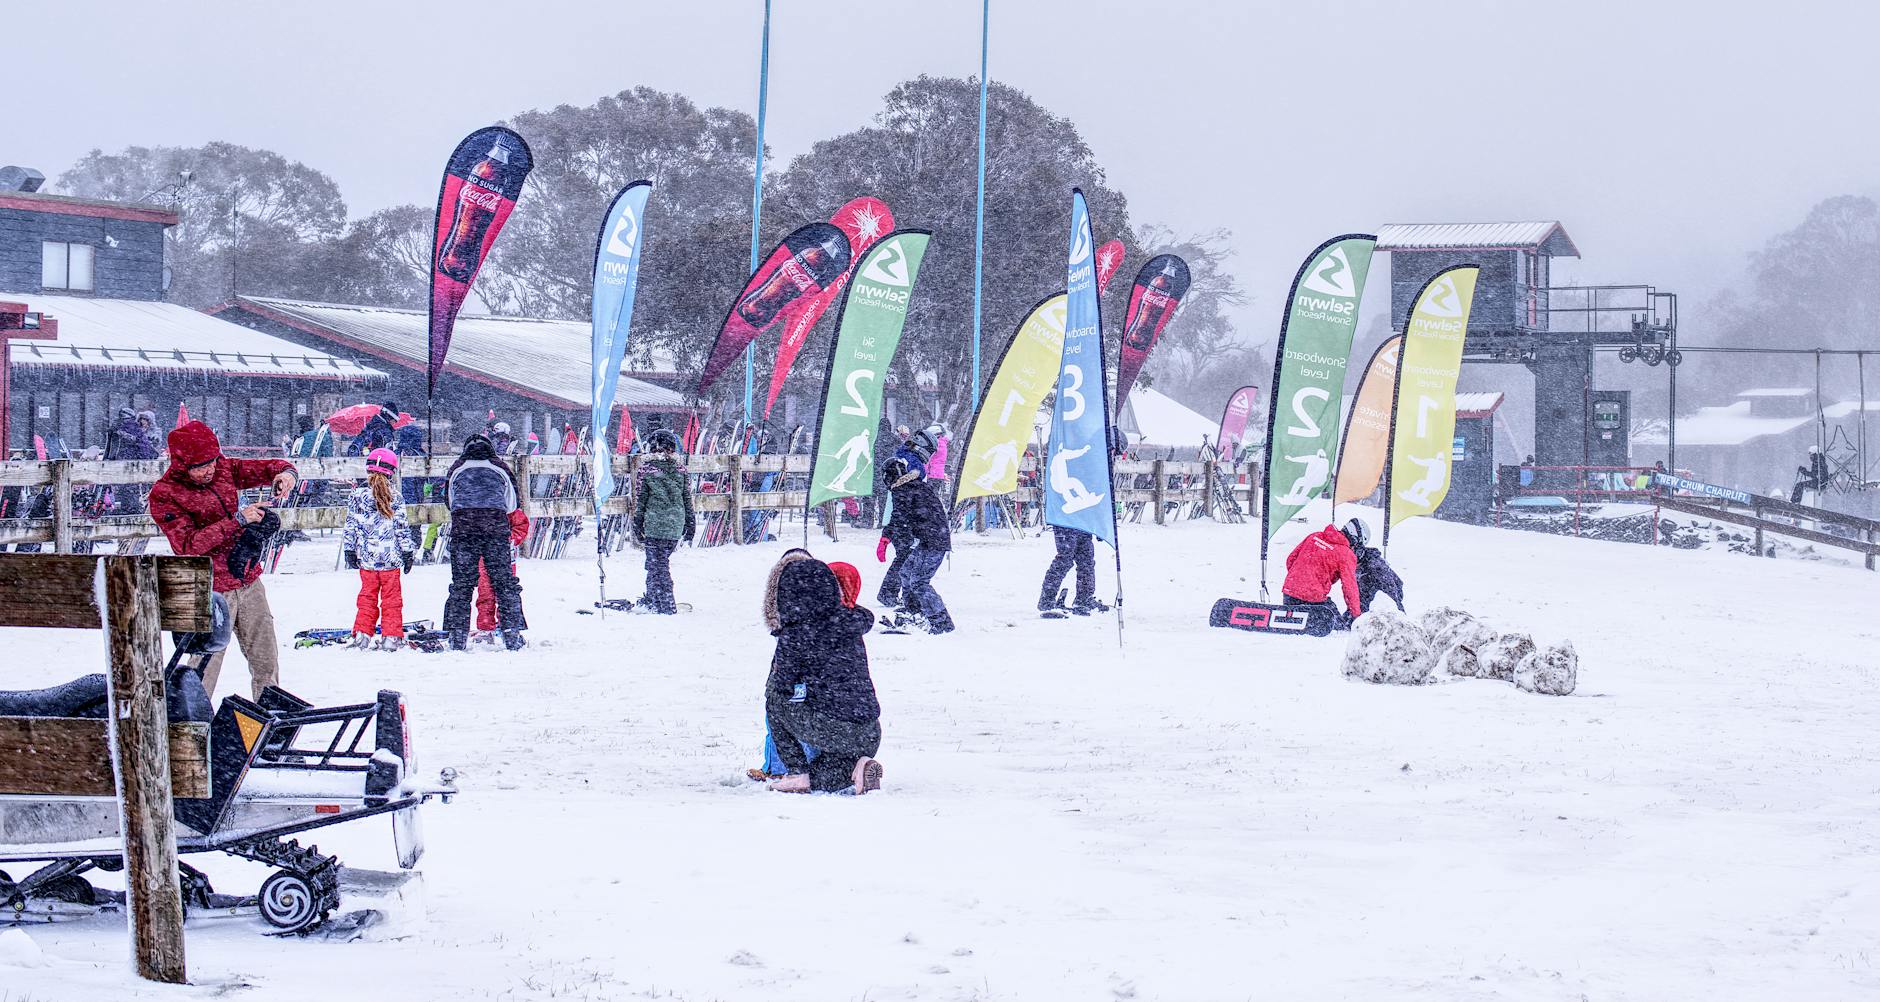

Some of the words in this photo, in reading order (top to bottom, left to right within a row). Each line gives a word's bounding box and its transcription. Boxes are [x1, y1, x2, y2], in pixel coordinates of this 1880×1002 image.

[468, 175, 478, 184] NO
[479, 180, 504, 195] SUGAR
[795, 253, 804, 263] NO
[801, 263, 820, 281] SUGAR
[1066, 323, 1097, 339] wboard
[1065, 341, 1082, 355] evel
[1063, 364, 1086, 421] 3
[1660, 474, 1680, 487] NEW
[1680, 479, 1705, 493] CHUM
[1705, 485, 1747, 502] CHAIRLIFT
